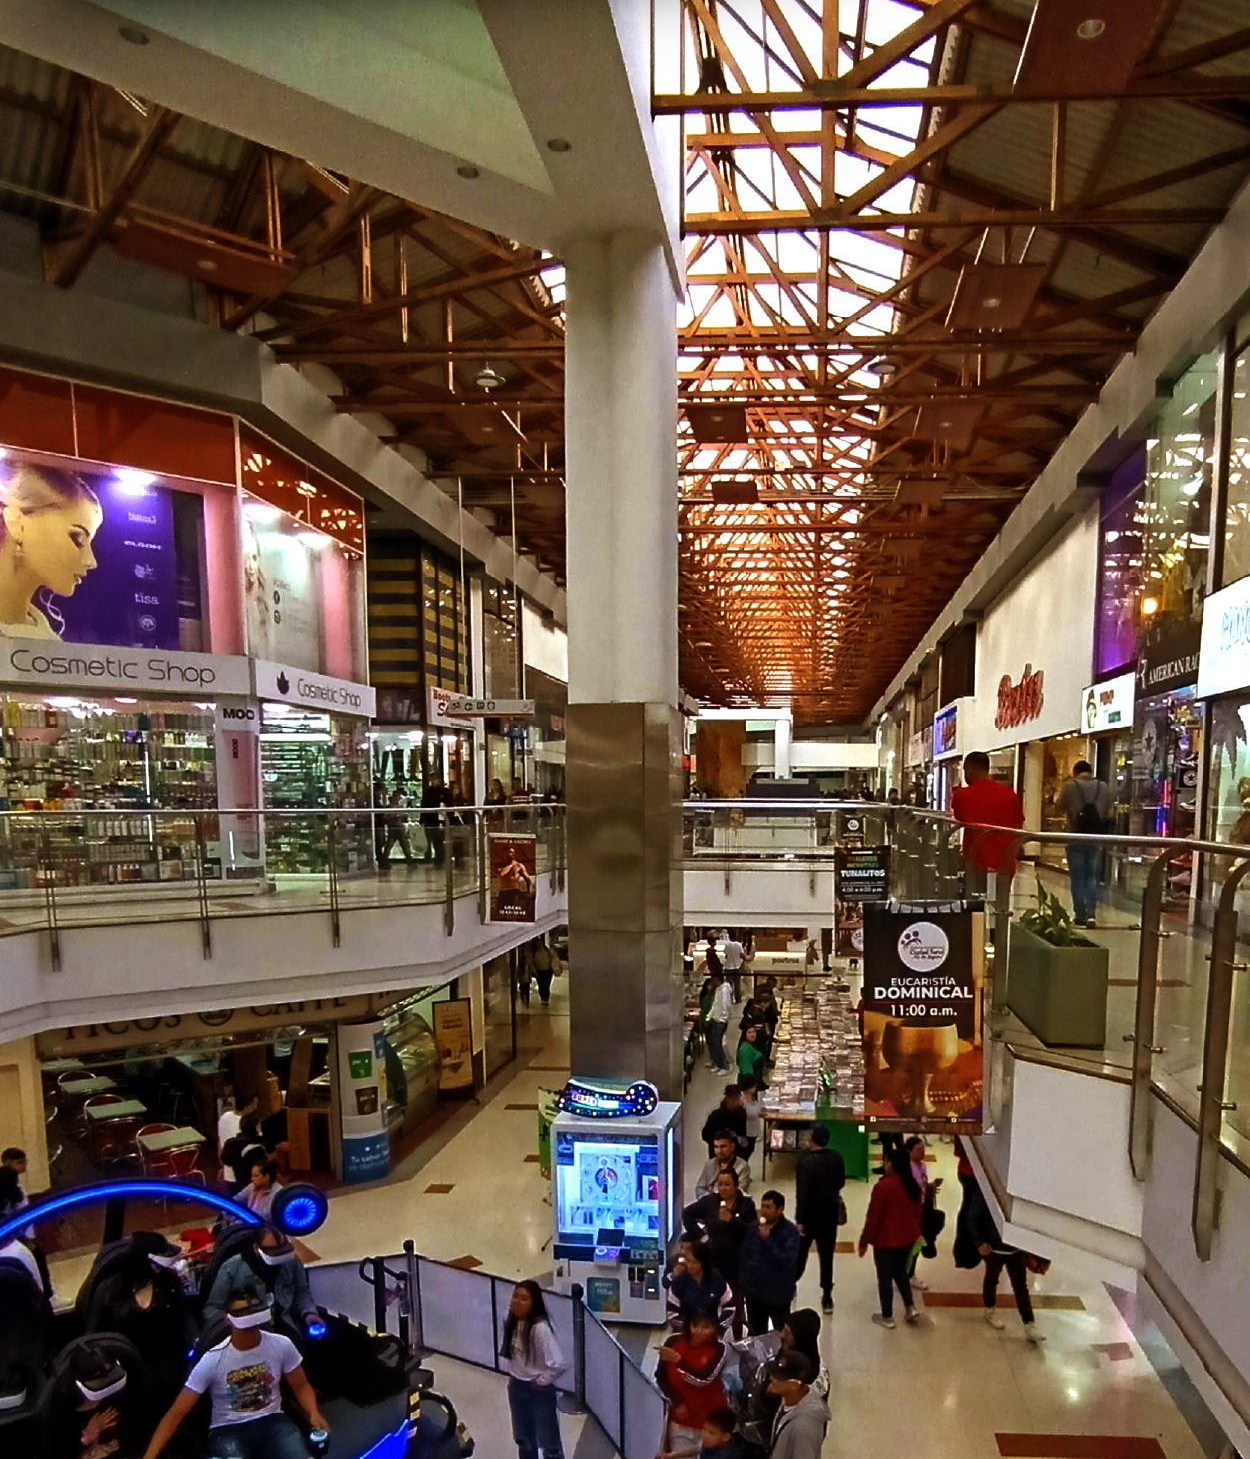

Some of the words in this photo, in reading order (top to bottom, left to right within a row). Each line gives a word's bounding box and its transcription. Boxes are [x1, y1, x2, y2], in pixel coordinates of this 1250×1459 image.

[10, 649, 139, 680] Cosmetic
[148, 659, 216, 687] Shop
[1148, 658, 1185, 685] AMERICAN
[297, 678, 338, 705] Cosmetic
[340, 686, 362, 708] Shop
[840, 869, 886, 878] TUNALITOS
[890, 976, 957, 987] EUCARISTÍA
[873, 986, 974, 1000] DOMINICAL
[890, 1004, 926, 1017] 11:00
[930, 1007, 958, 1016] a.m.
